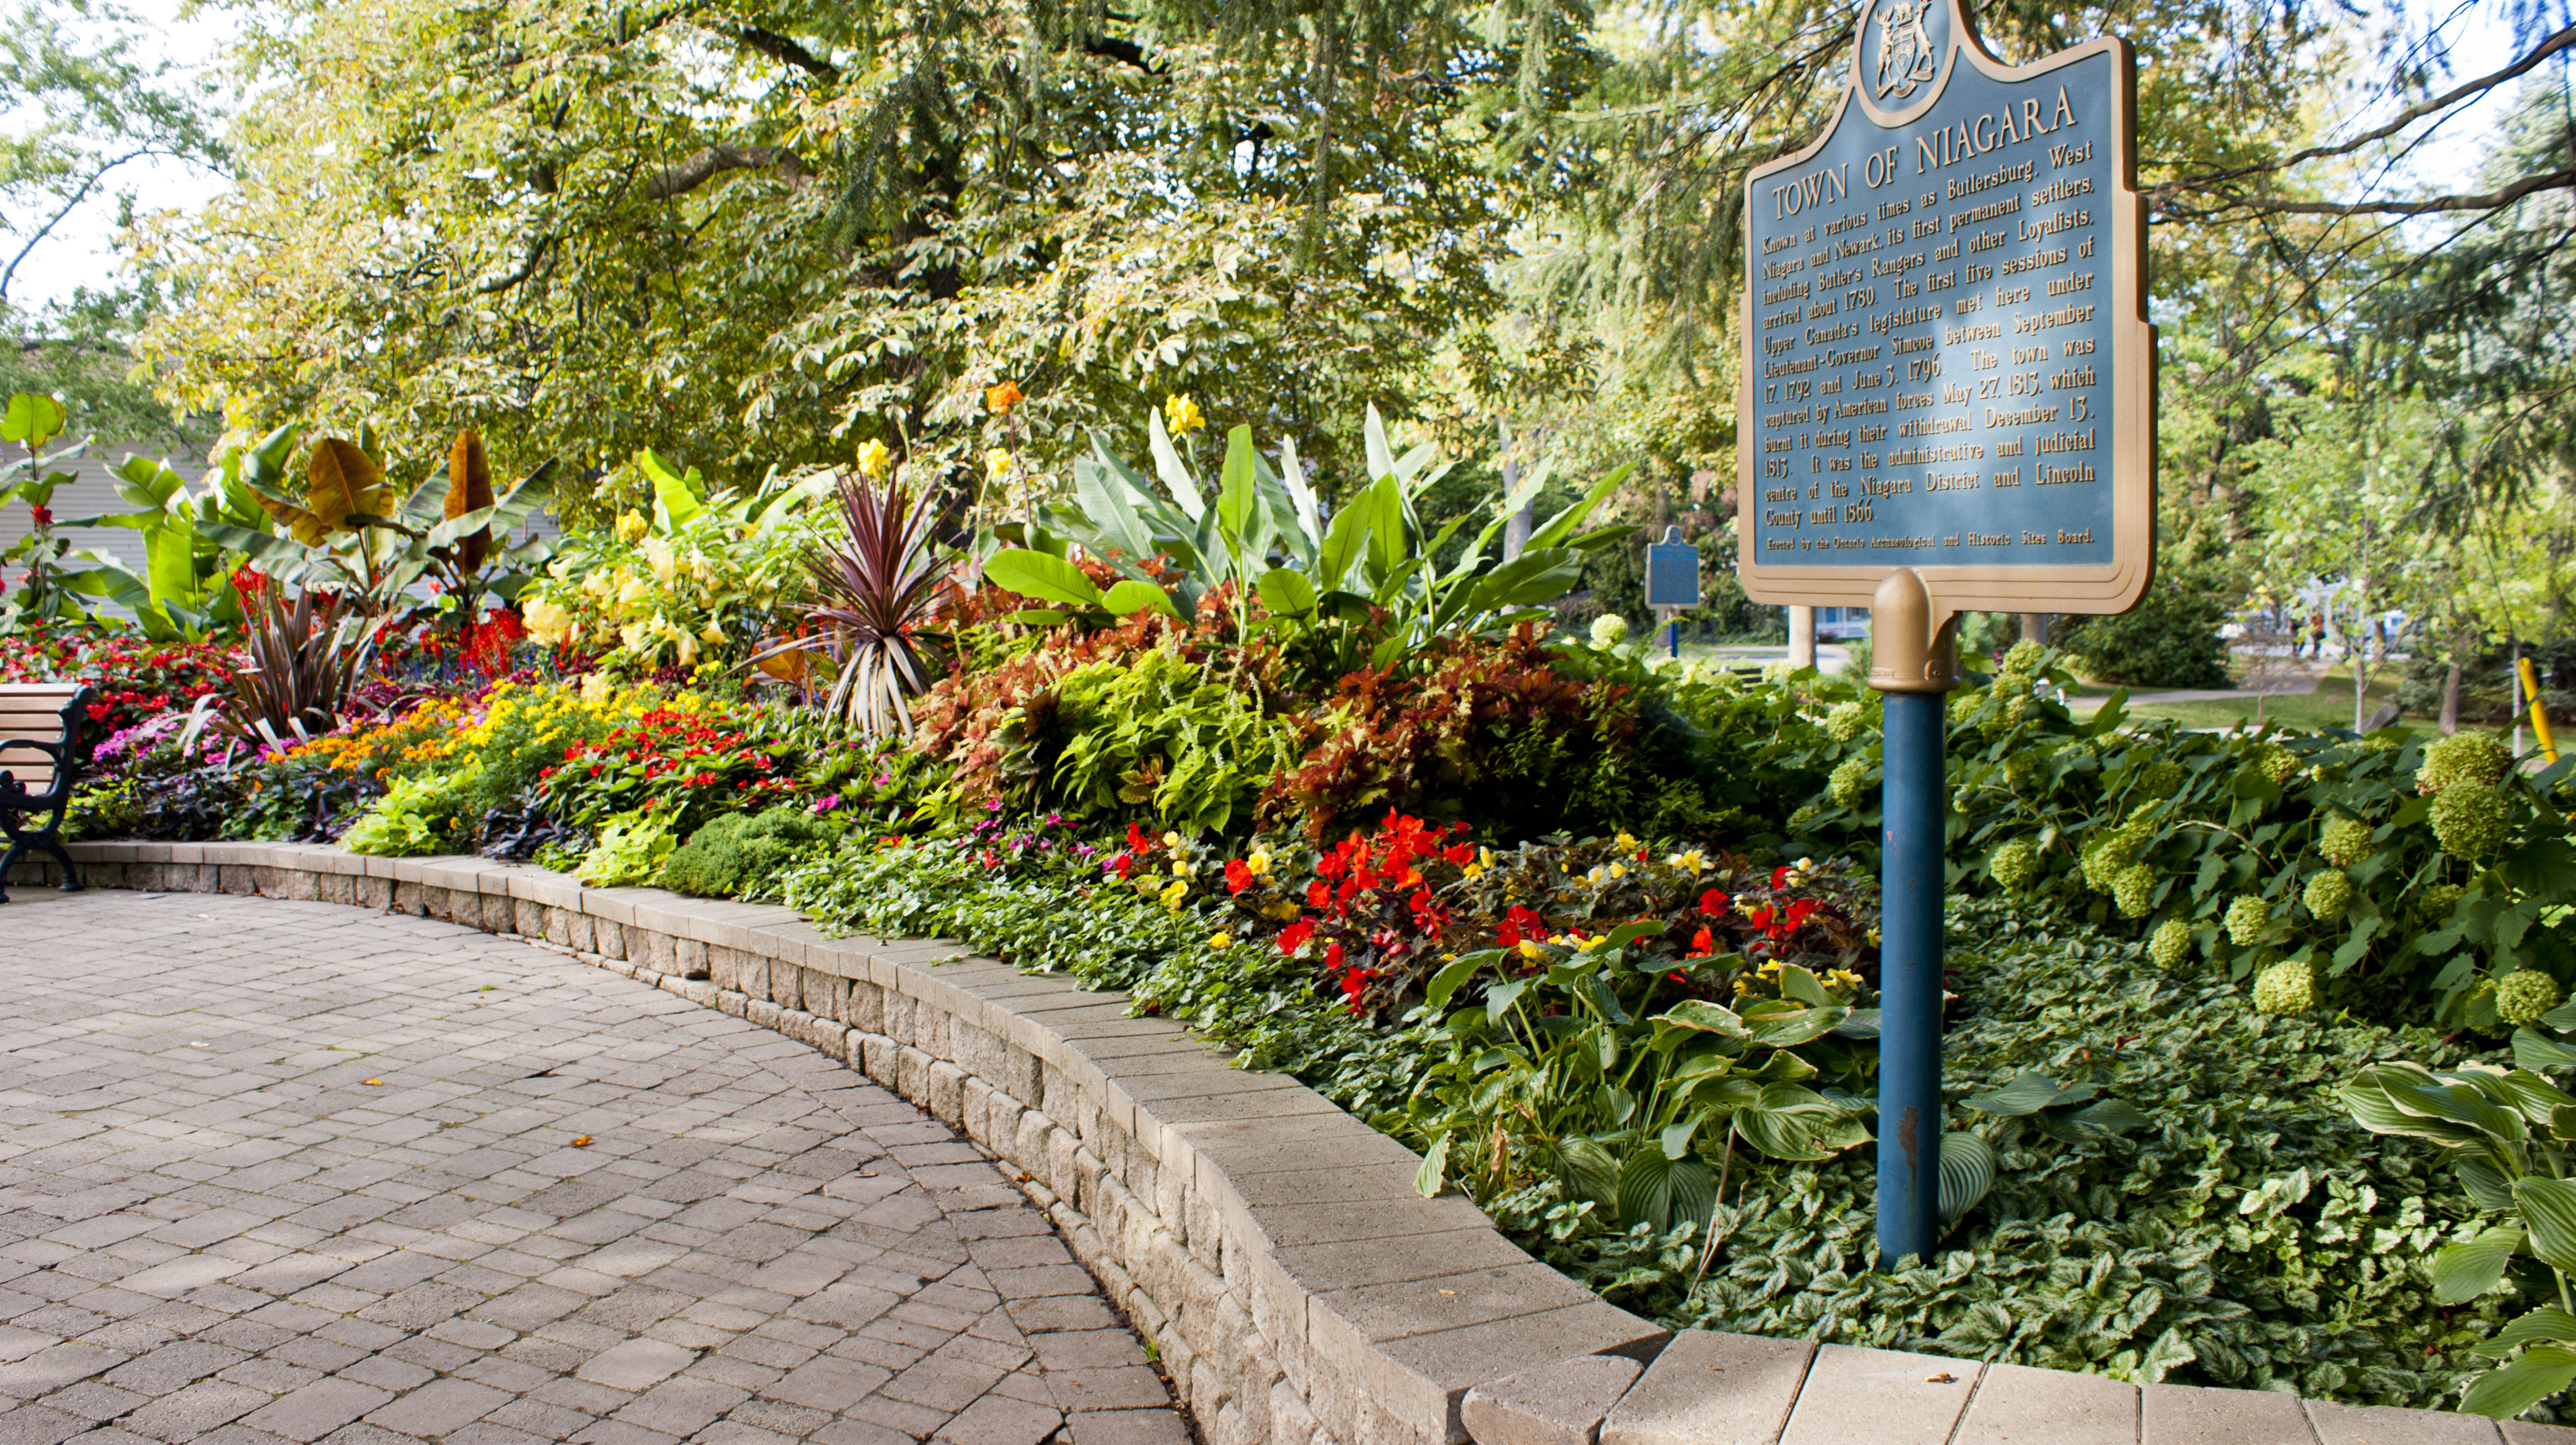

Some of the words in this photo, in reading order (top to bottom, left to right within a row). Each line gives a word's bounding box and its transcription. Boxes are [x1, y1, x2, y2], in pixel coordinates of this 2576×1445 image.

[1773, 163, 1848, 220] TOWN
[1865, 145, 1898, 188] OF
[1916, 84, 2077, 174] NIAGARA
[1763, 234, 1796, 255] Known
[1805, 225, 1815, 242] at
[1824, 211, 1867, 236] various
[1878, 198, 1910, 220] times
[1921, 191, 1936, 208] as
[2048, 140, 2092, 169] West
[1763, 257, 1804, 280] Niagara
[1810, 246, 1829, 267] and
[1888, 227, 1904, 246] its
[1912, 215, 1941, 239] first
[1949, 194, 2021, 234] permanent
[1763, 280, 1810, 305] including
[1818, 268, 1862, 291] Butler's
[1871, 252, 1925, 278] Rangers
[1935, 238, 1959, 261] and
[1969, 230, 2007, 252] other
[1763, 305, 1801, 329] arrived
[1808, 298, 1837, 319] about
[1844, 286, 1878, 311] 1780.
[1894, 278, 1917, 299] The
[1927, 269, 1955, 292] first
[1966, 263, 1993, 284] five
[2002, 247, 2067, 275] sessions
[2078, 234, 2094, 258] of
[1764, 335, 1795, 357] Upper
[1805, 322, 1859, 345] Canada's
[1869, 305, 1942, 334] legislature
[1956, 292, 1982, 314] met
[1996, 286, 2030, 307] here
[2047, 271, 2094, 296] under
[1764, 345, 1880, 379] Lieutenant-Governor
[1892, 335, 1933, 356] Simcoe
[1945, 322, 2000, 346] between
[2013, 303, 2094, 336] September
[1784, 379, 1811, 402] 1792
[1820, 375, 1842, 394] and
[1852, 370, 1881, 389] June
[1908, 351, 1946, 384] 1796.
[1970, 349, 1998, 371] The
[2012, 346, 2048, 365] town
[2063, 338, 2095, 357] was
[1764, 405, 1810, 431] captured
[1816, 403, 1829, 424] by
[1833, 397, 1888, 418] American
[1896, 392, 1933, 411] forces
[1943, 382, 1972, 407] May
[2050, 364, 2096, 390] which
[1764, 435, 1792, 453] burnt
[1800, 432, 1809, 449] it
[1814, 429, 1851, 448] during
[1859, 423, 1887, 443] their
[1898, 411, 1972, 438] withdrawal
[1985, 402, 2059, 427] December
[1764, 457, 1793, 479] 1813.
[1811, 454, 1820, 473] It
[1829, 457, 1851, 471] was
[1860, 450, 1878, 469] the
[1888, 441, 1984, 467] administrative
[1997, 435, 2023, 457] and
[2035, 427, 2095, 456] judicial
[1765, 485, 1797, 501] centre
[1808, 481, 1819, 499] of
[1830, 480, 1848, 498] the
[1860, 475, 1912, 499] Niagara
[1926, 470, 1979, 491] District
[1994, 466, 2021, 487] and
[2035, 461, 2095, 485] Lincoln
[1765, 508, 1802, 529] County
[1810, 505, 1837, 524] until
[1844, 498, 1878, 523] 1866.
[1767, 536, 1795, 550] Erected
[1801, 536, 1811, 551] by
[1816, 536, 1829, 549] the
[1833, 535, 1864, 549] Ontario
[1870, 533, 1935, 550] Archaeological
[1942, 532, 1959, 546] and
[1968, 532, 2011, 546] Historic
[2021, 530, 2046, 545] Sites
[2057, 528, 2094, 544] Board.
